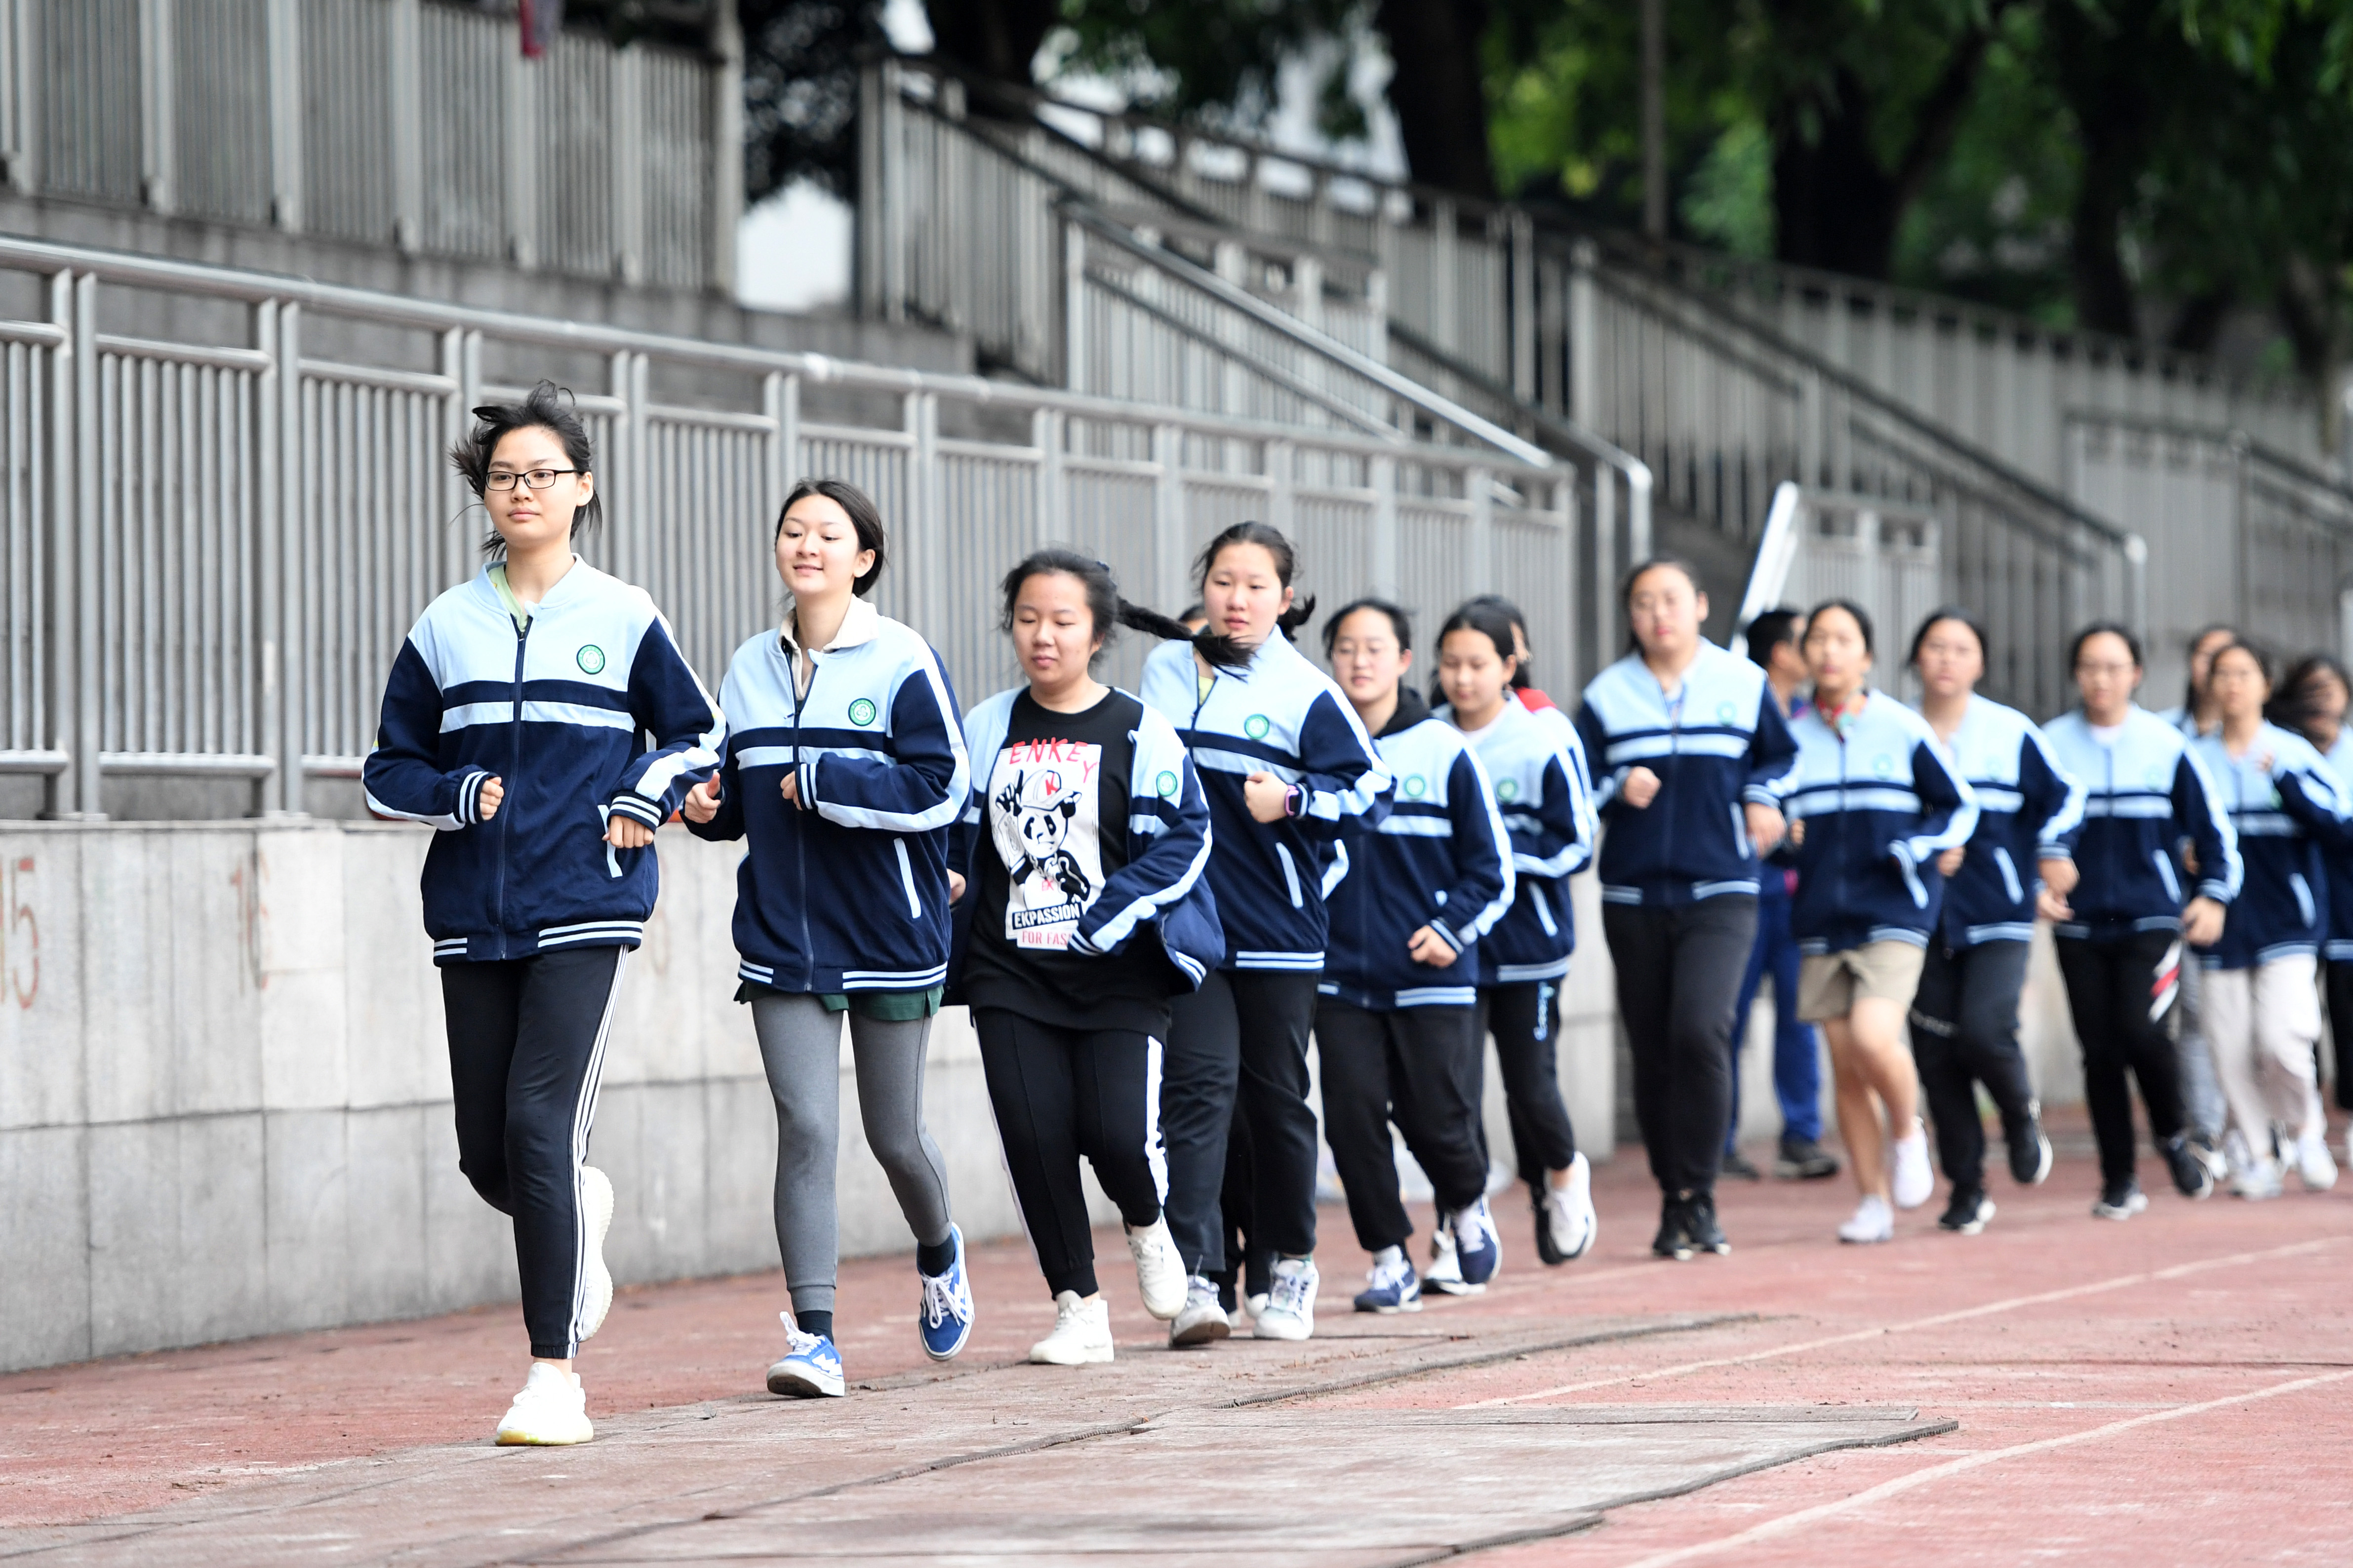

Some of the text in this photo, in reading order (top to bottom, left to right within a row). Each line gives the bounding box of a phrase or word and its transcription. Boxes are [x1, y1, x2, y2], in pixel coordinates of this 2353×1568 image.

[1009, 737, 1098, 784] ENKEY
[1045, 773, 1059, 795] K
[1014, 903, 1080, 928] EKPASSION
[1022, 931, 1072, 945] FOR FAS
